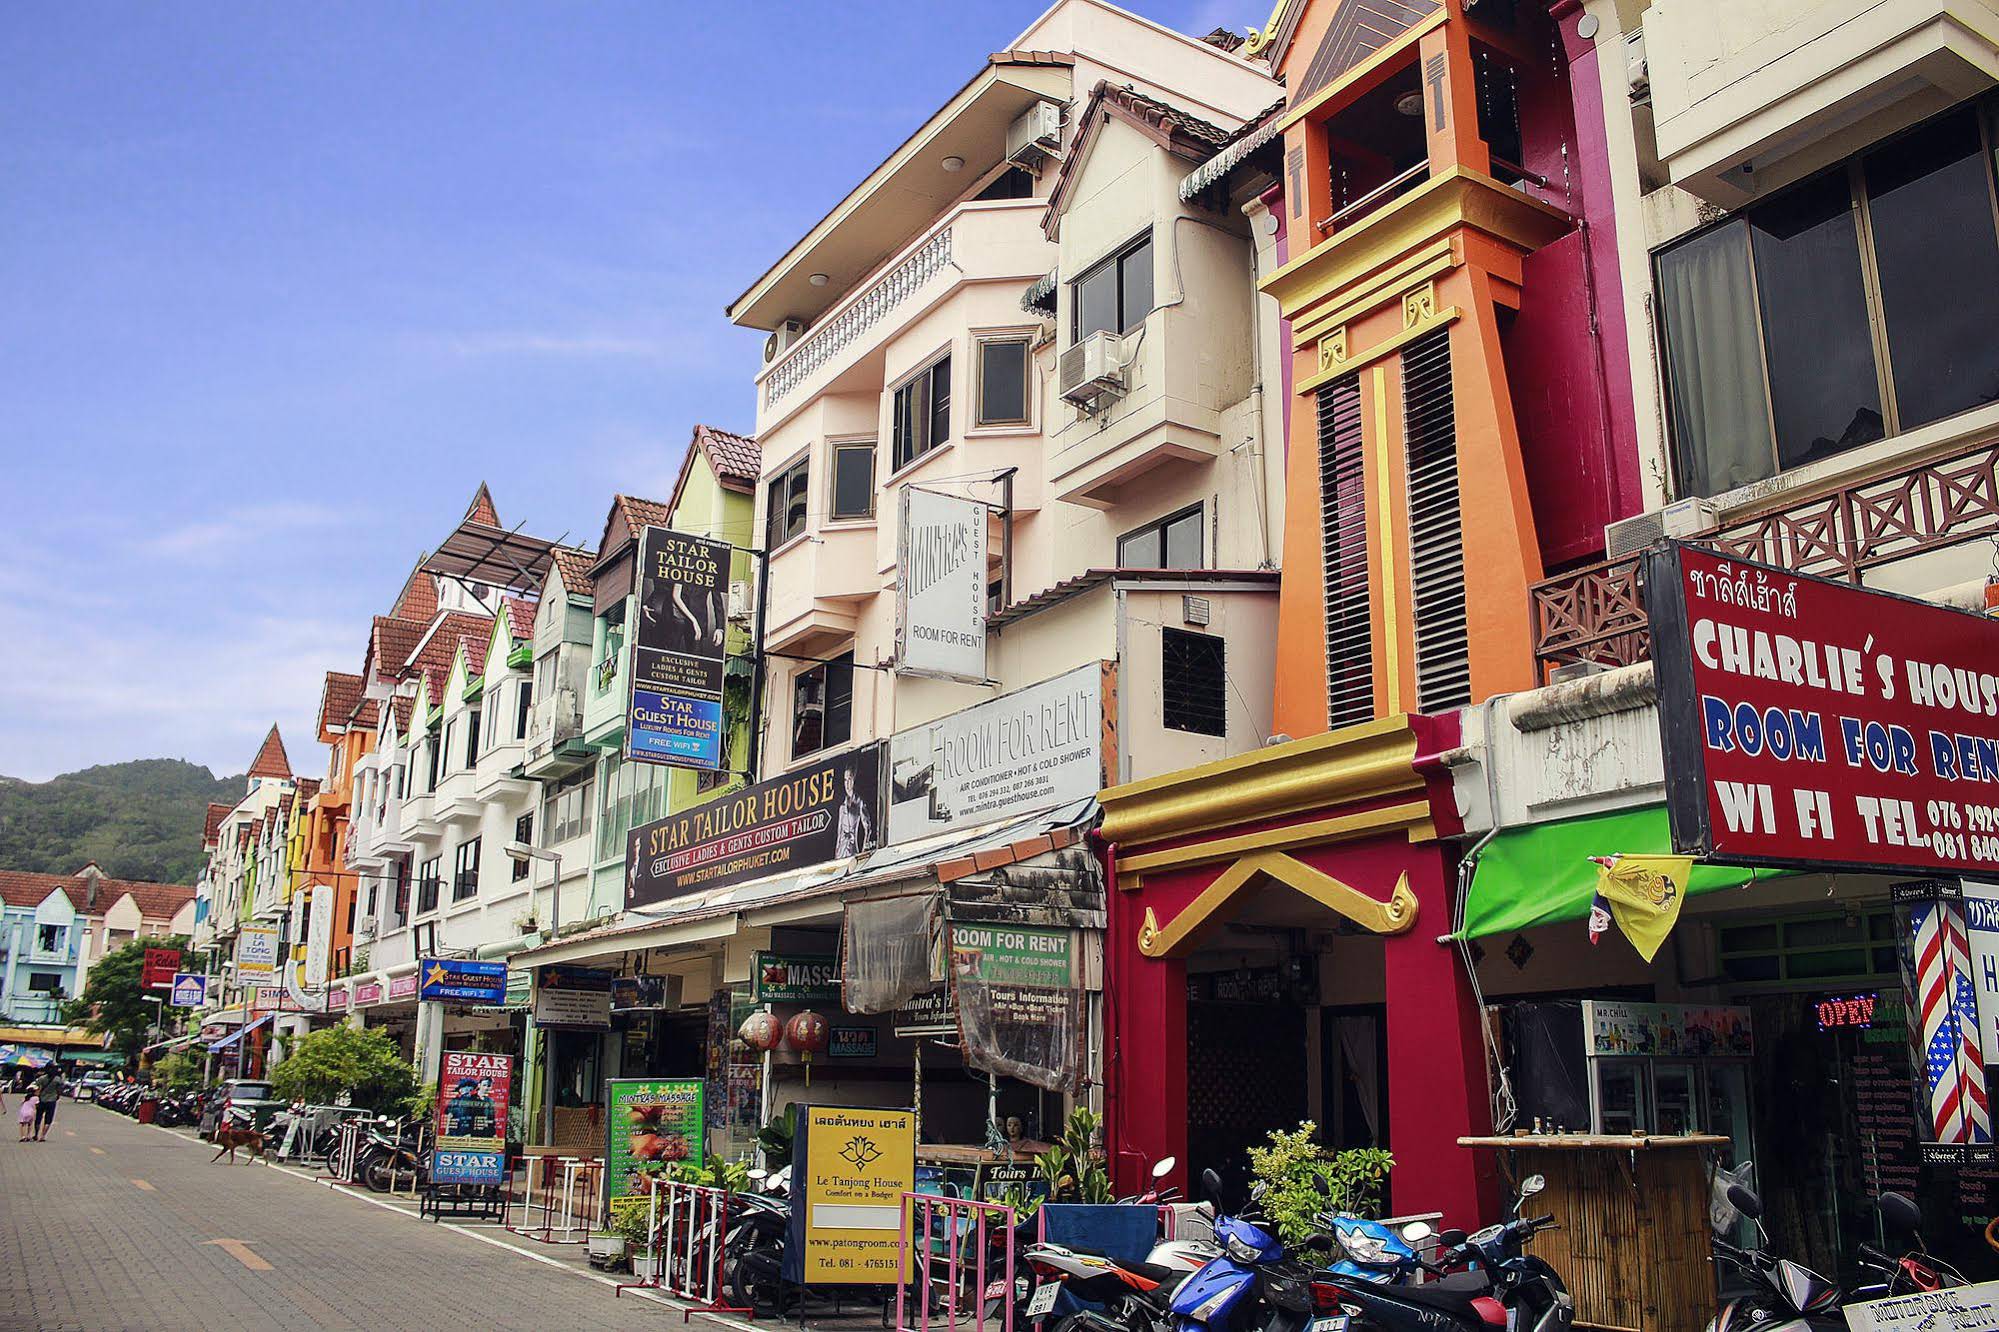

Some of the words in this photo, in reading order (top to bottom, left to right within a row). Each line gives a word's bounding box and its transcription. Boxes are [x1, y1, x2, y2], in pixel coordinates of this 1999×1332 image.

[972, 507, 980, 560] GUEST
[666, 539, 710, 559] STAR
[656, 551, 718, 574] TAILOR
[657, 566, 715, 587] HOUSE
[913, 624, 940, 642] ROOM
[941, 629, 958, 646] FOR
[960, 633, 982, 649] RENT
[651, 662, 676, 673] LADIES
[661, 656, 699, 668] EXCLUSIVE
[651, 672, 680, 682] CUSTOM
[1904, 659, 1999, 717] HOUS
[660, 696, 693, 714] STAR
[634, 708, 674, 724] GUEST
[676, 713, 717, 732] HOUSE
[648, 737, 672, 748] FREE
[942, 722, 993, 781] ROOM
[998, 709, 1035, 764] FOR
[1040, 690, 1095, 752] RENT
[1701, 694, 1827, 763] ROOM
[1839, 715, 1919, 776] FOR
[1928, 730, 1999, 784] REN
[959, 781, 970, 792] AIR
[971, 770, 1013, 790] CONDITIONER
[1017, 764, 1032, 776] HOT
[1032, 763, 1038, 772] &
[1039, 757, 1058, 770] COLD
[1060, 748, 1091, 764] SHOWER
[968, 794, 976, 803] TEL
[650, 824, 690, 857] STAR
[693, 796, 758, 842] TAILOR
[762, 768, 836, 821] HOUSE
[1713, 780, 1777, 835] WI
[1793, 789, 1835, 840] FI
[1856, 795, 1931, 848] TEL.
[1927, 800, 1962, 830] 076
[654, 852, 690, 874] EXCLUSIVE
[692, 844, 719, 865] LADIES
[720, 844, 726, 856] &
[728, 834, 753, 853] GENTS
[754, 826, 790, 847] CUSTOM
[792, 814, 825, 836] TAILOR
[1932, 831, 1968, 861] 081
[676, 847, 790, 888] WWW.STARTAILORPHUKET.COM
[996, 931, 1025, 950] FOR
[1029, 936, 1068, 953] RENT
[1000, 955, 1014, 964] HOT
[1021, 957, 1039, 966] COLD
[1040, 958, 1067, 969] SHOWER
[440, 988, 460, 996] FREE
[990, 989, 1016, 1001] Tours
[1019, 992, 1069, 1004] Information
[1819, 999, 1874, 1027] OPEN
[448, 1054, 509, 1070] STAR
[446, 1067, 478, 1076] TAILOR
[480, 1068, 509, 1078] HOUSE
[659, 1094, 697, 1103] MASSAGE
[440, 1155, 498, 1168] STAR
[436, 1168, 466, 1176] GUEST
[469, 1168, 500, 1177] HOUSE
[990, 1166, 1026, 1180] Tours
[817, 1176, 829, 1186] Le
[832, 1176, 870, 1190] Tanjong
[874, 1177, 903, 1188] House
[826, 1189, 852, 1197] Comfort
[871, 1191, 894, 1199] Budget
[819, 1258, 834, 1268] Tel.
[839, 1258, 854, 1268] 081
